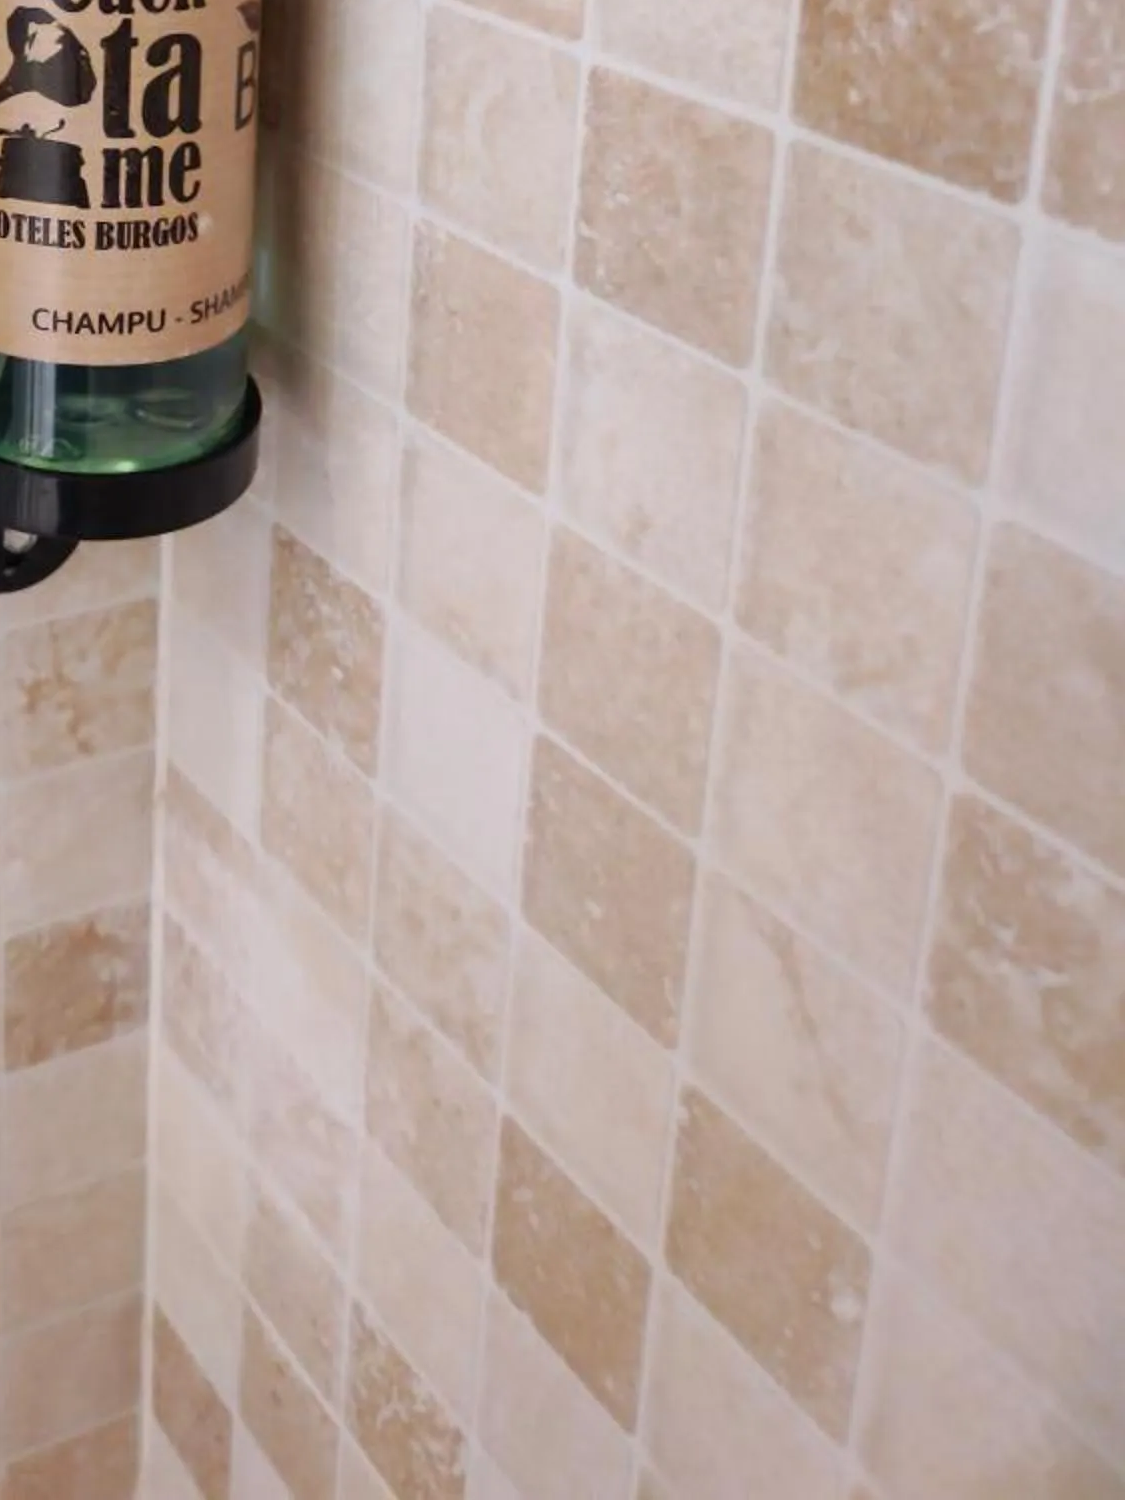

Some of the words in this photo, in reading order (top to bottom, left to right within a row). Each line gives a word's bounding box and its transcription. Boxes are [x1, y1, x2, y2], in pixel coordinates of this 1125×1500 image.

[100, 18, 203, 140] ta
[102, 141, 203, 209] me
[95, 211, 199, 251] BURGOS
[32, 307, 167, 336] CHAMPU
